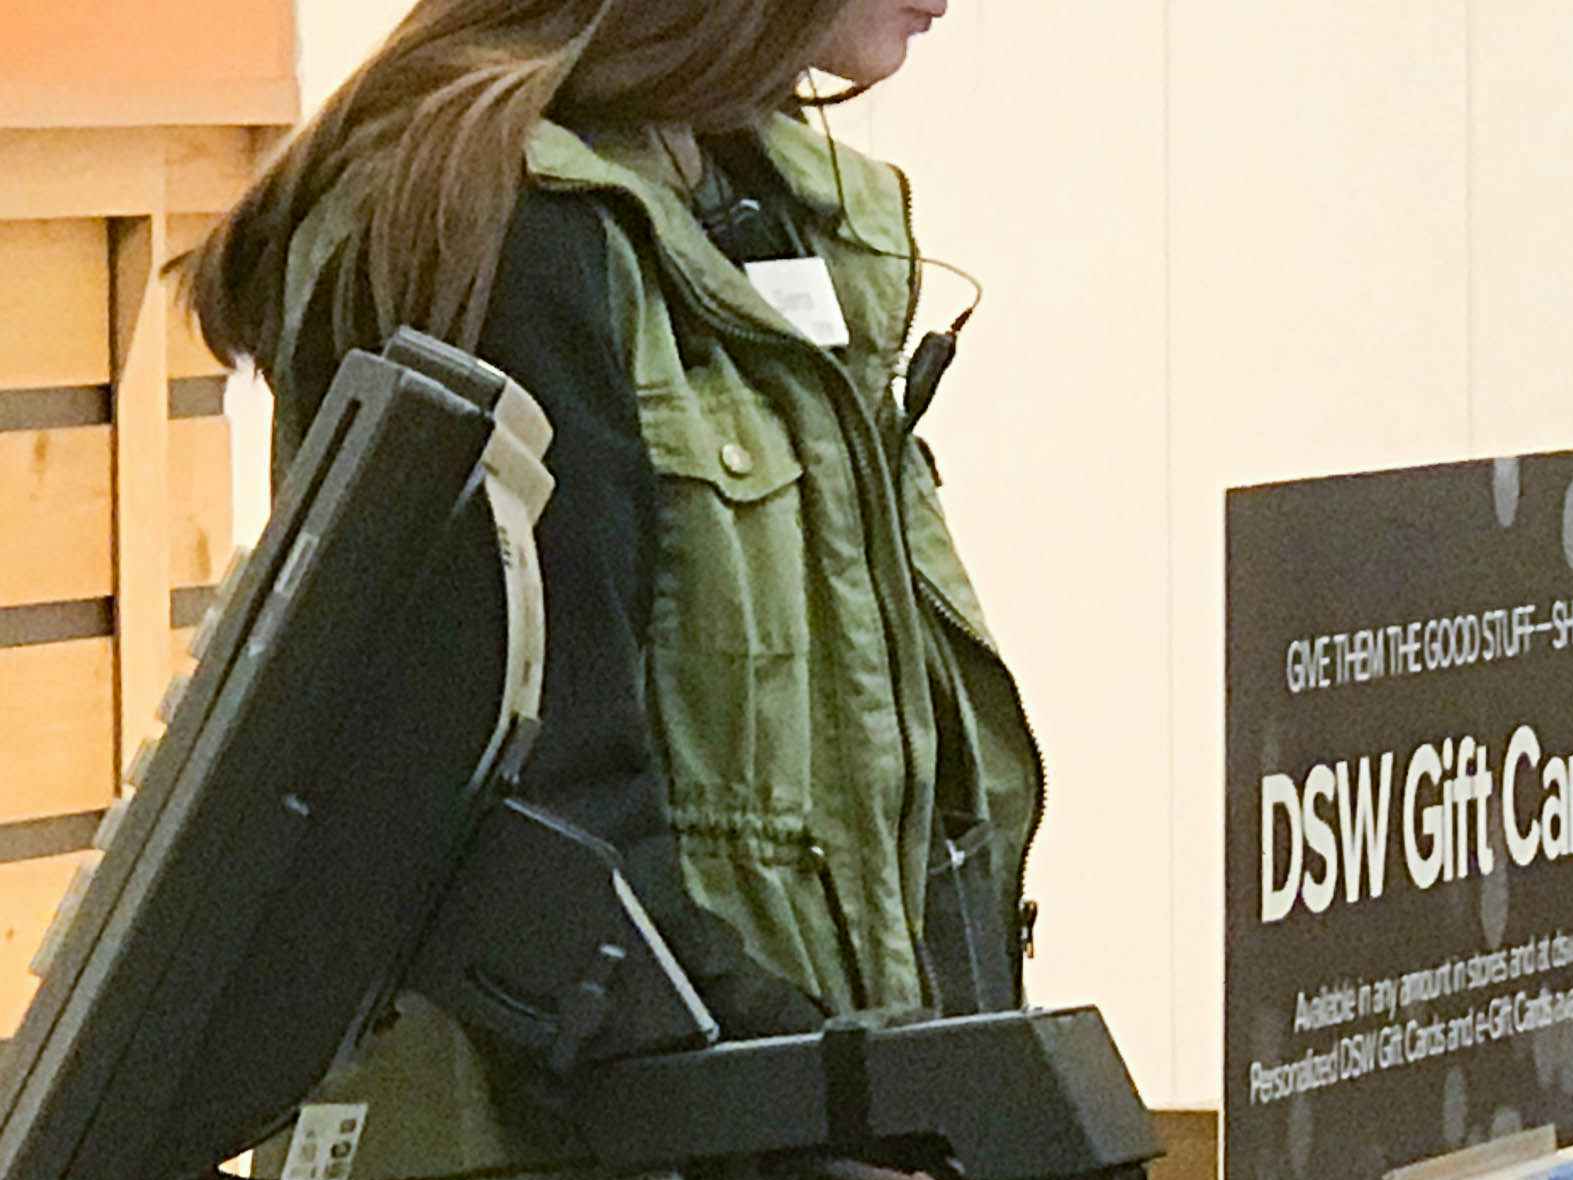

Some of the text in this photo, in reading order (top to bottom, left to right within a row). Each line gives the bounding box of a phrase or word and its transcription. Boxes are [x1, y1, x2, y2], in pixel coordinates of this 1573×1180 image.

[1286, 635, 1331, 694] GIVE
[1333, 629, 1385, 685] THEM
[1387, 621, 1422, 674] THE
[1424, 612, 1480, 670] GOOD
[1260, 750, 1394, 924] DSW
[1402, 736, 1494, 891] Gift
[1341, 1031, 1377, 1080] DSW
